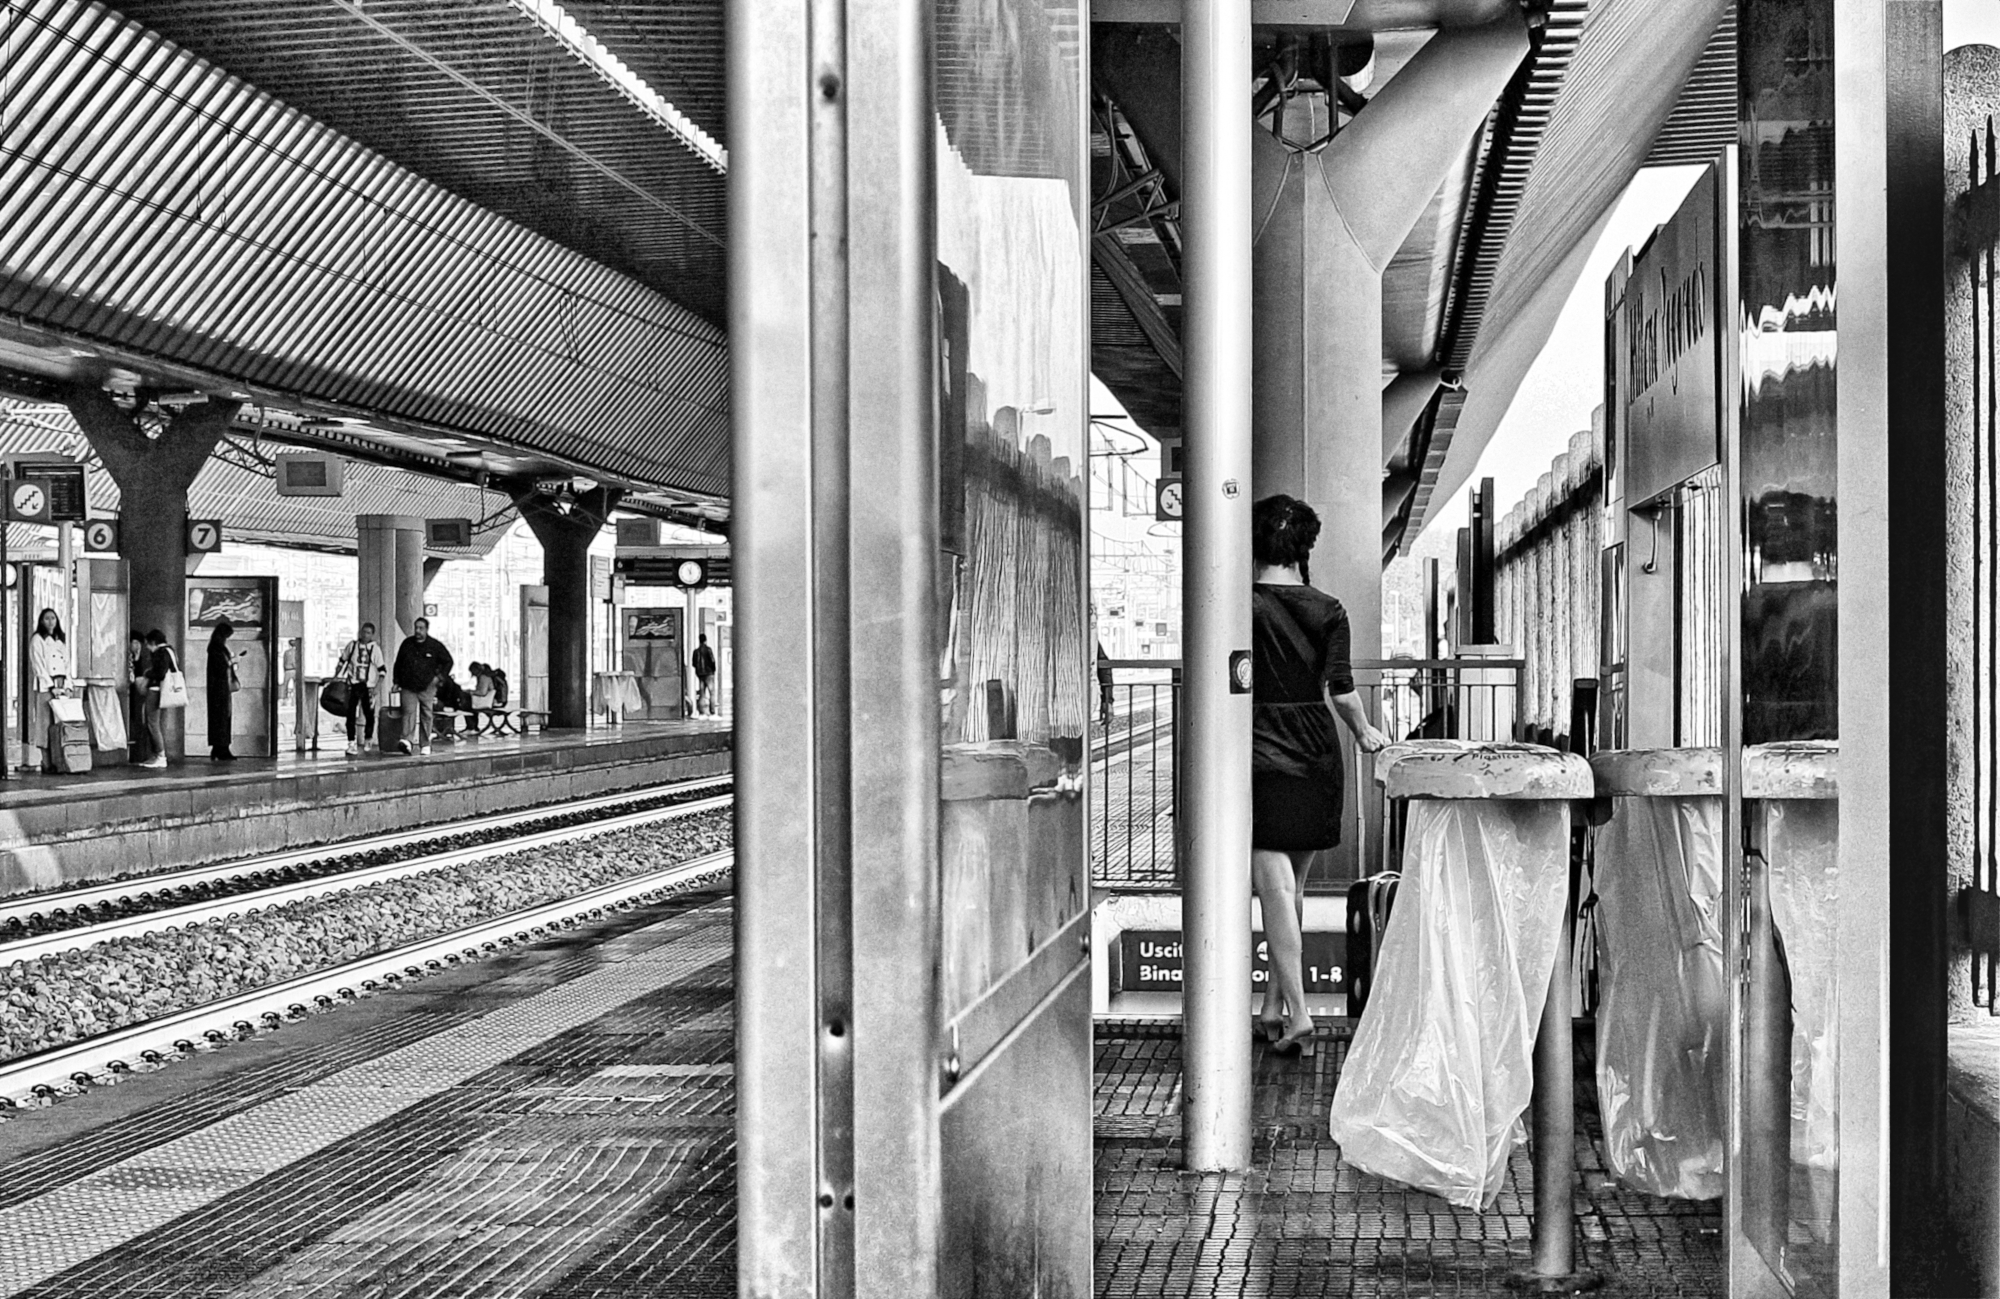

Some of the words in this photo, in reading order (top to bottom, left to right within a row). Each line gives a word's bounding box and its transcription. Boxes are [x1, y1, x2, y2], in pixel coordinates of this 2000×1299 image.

[93, 527, 107, 545] 6
[197, 527, 211, 545] 7
[1309, 966, 1343, 983] 1-8
